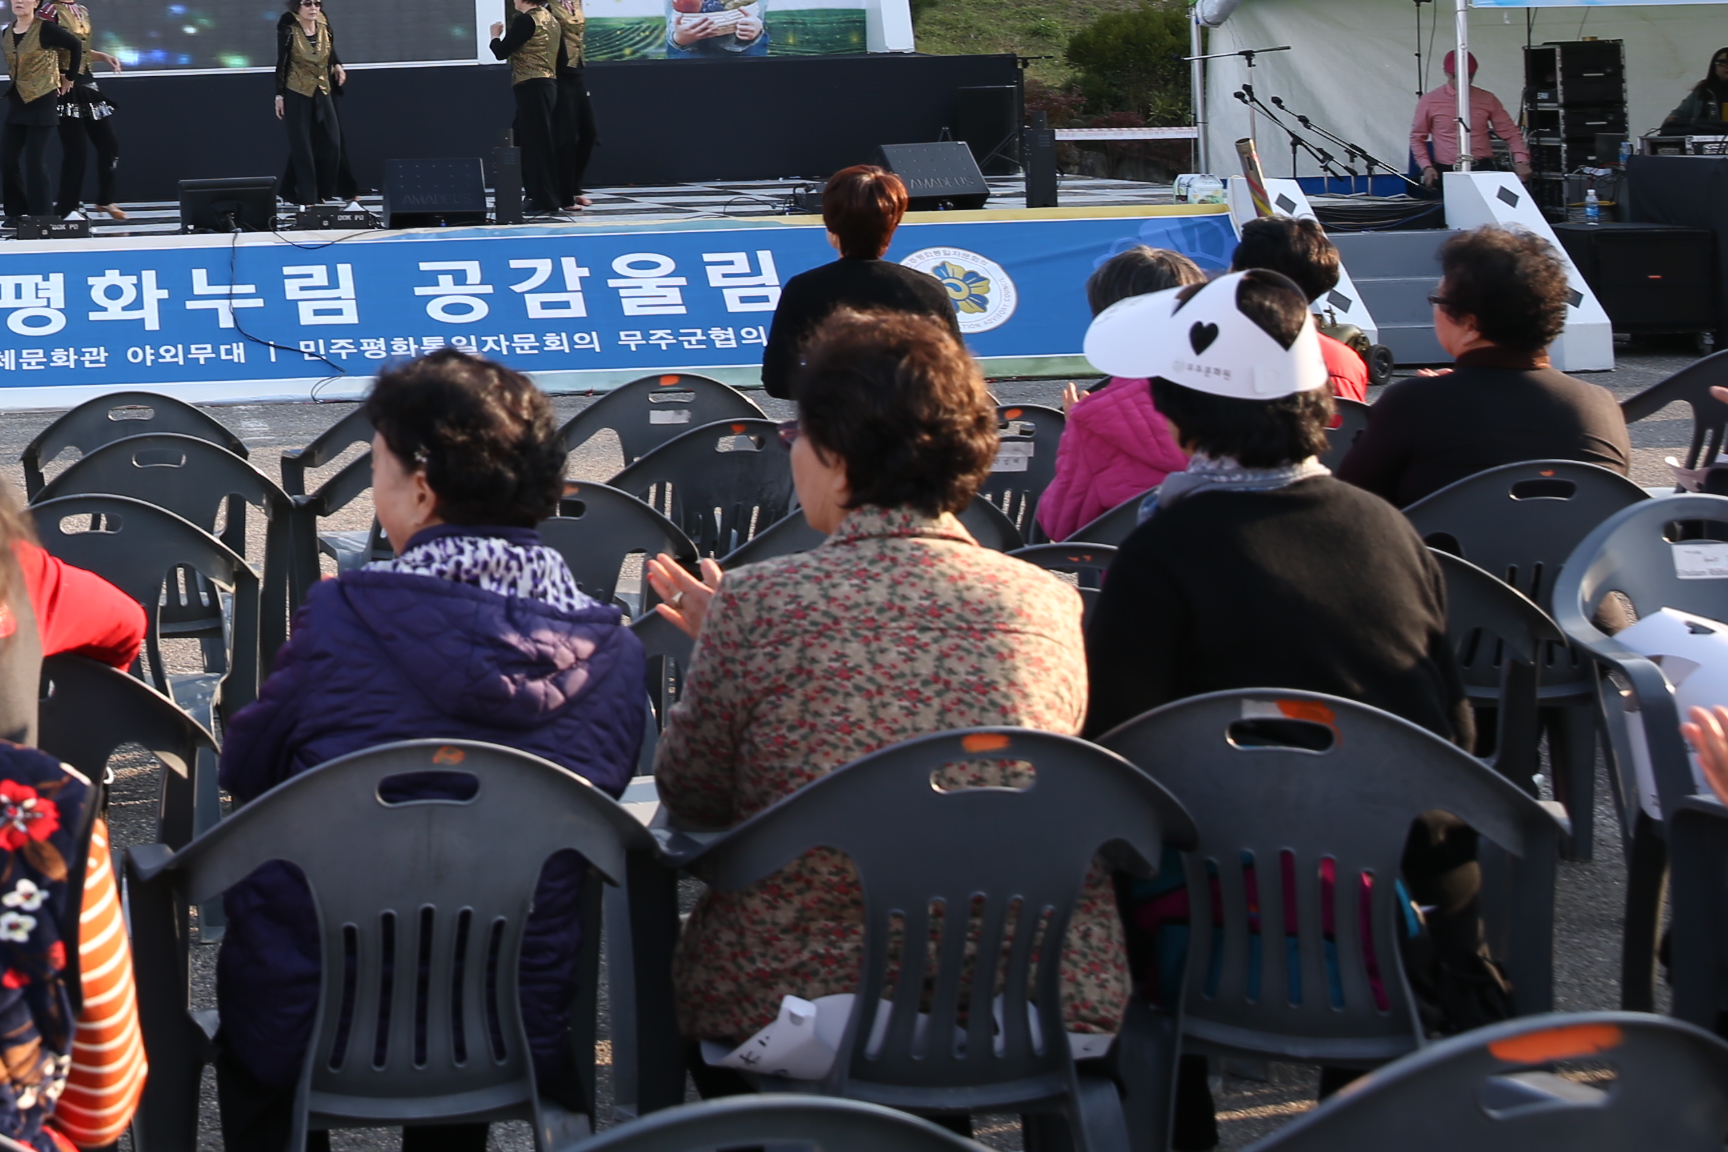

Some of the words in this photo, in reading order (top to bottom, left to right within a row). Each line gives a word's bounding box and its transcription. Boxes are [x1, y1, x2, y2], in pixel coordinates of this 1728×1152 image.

[414, 250, 784, 325] 공감울림
[959, 322, 981, 330] TION
[983, 303, 1010, 327] ADVISORY
[126, 342, 246, 368] 야외무대
[298, 330, 602, 362] 민주평화통일자문회의
[617, 327, 769, 353] 무주군협의
